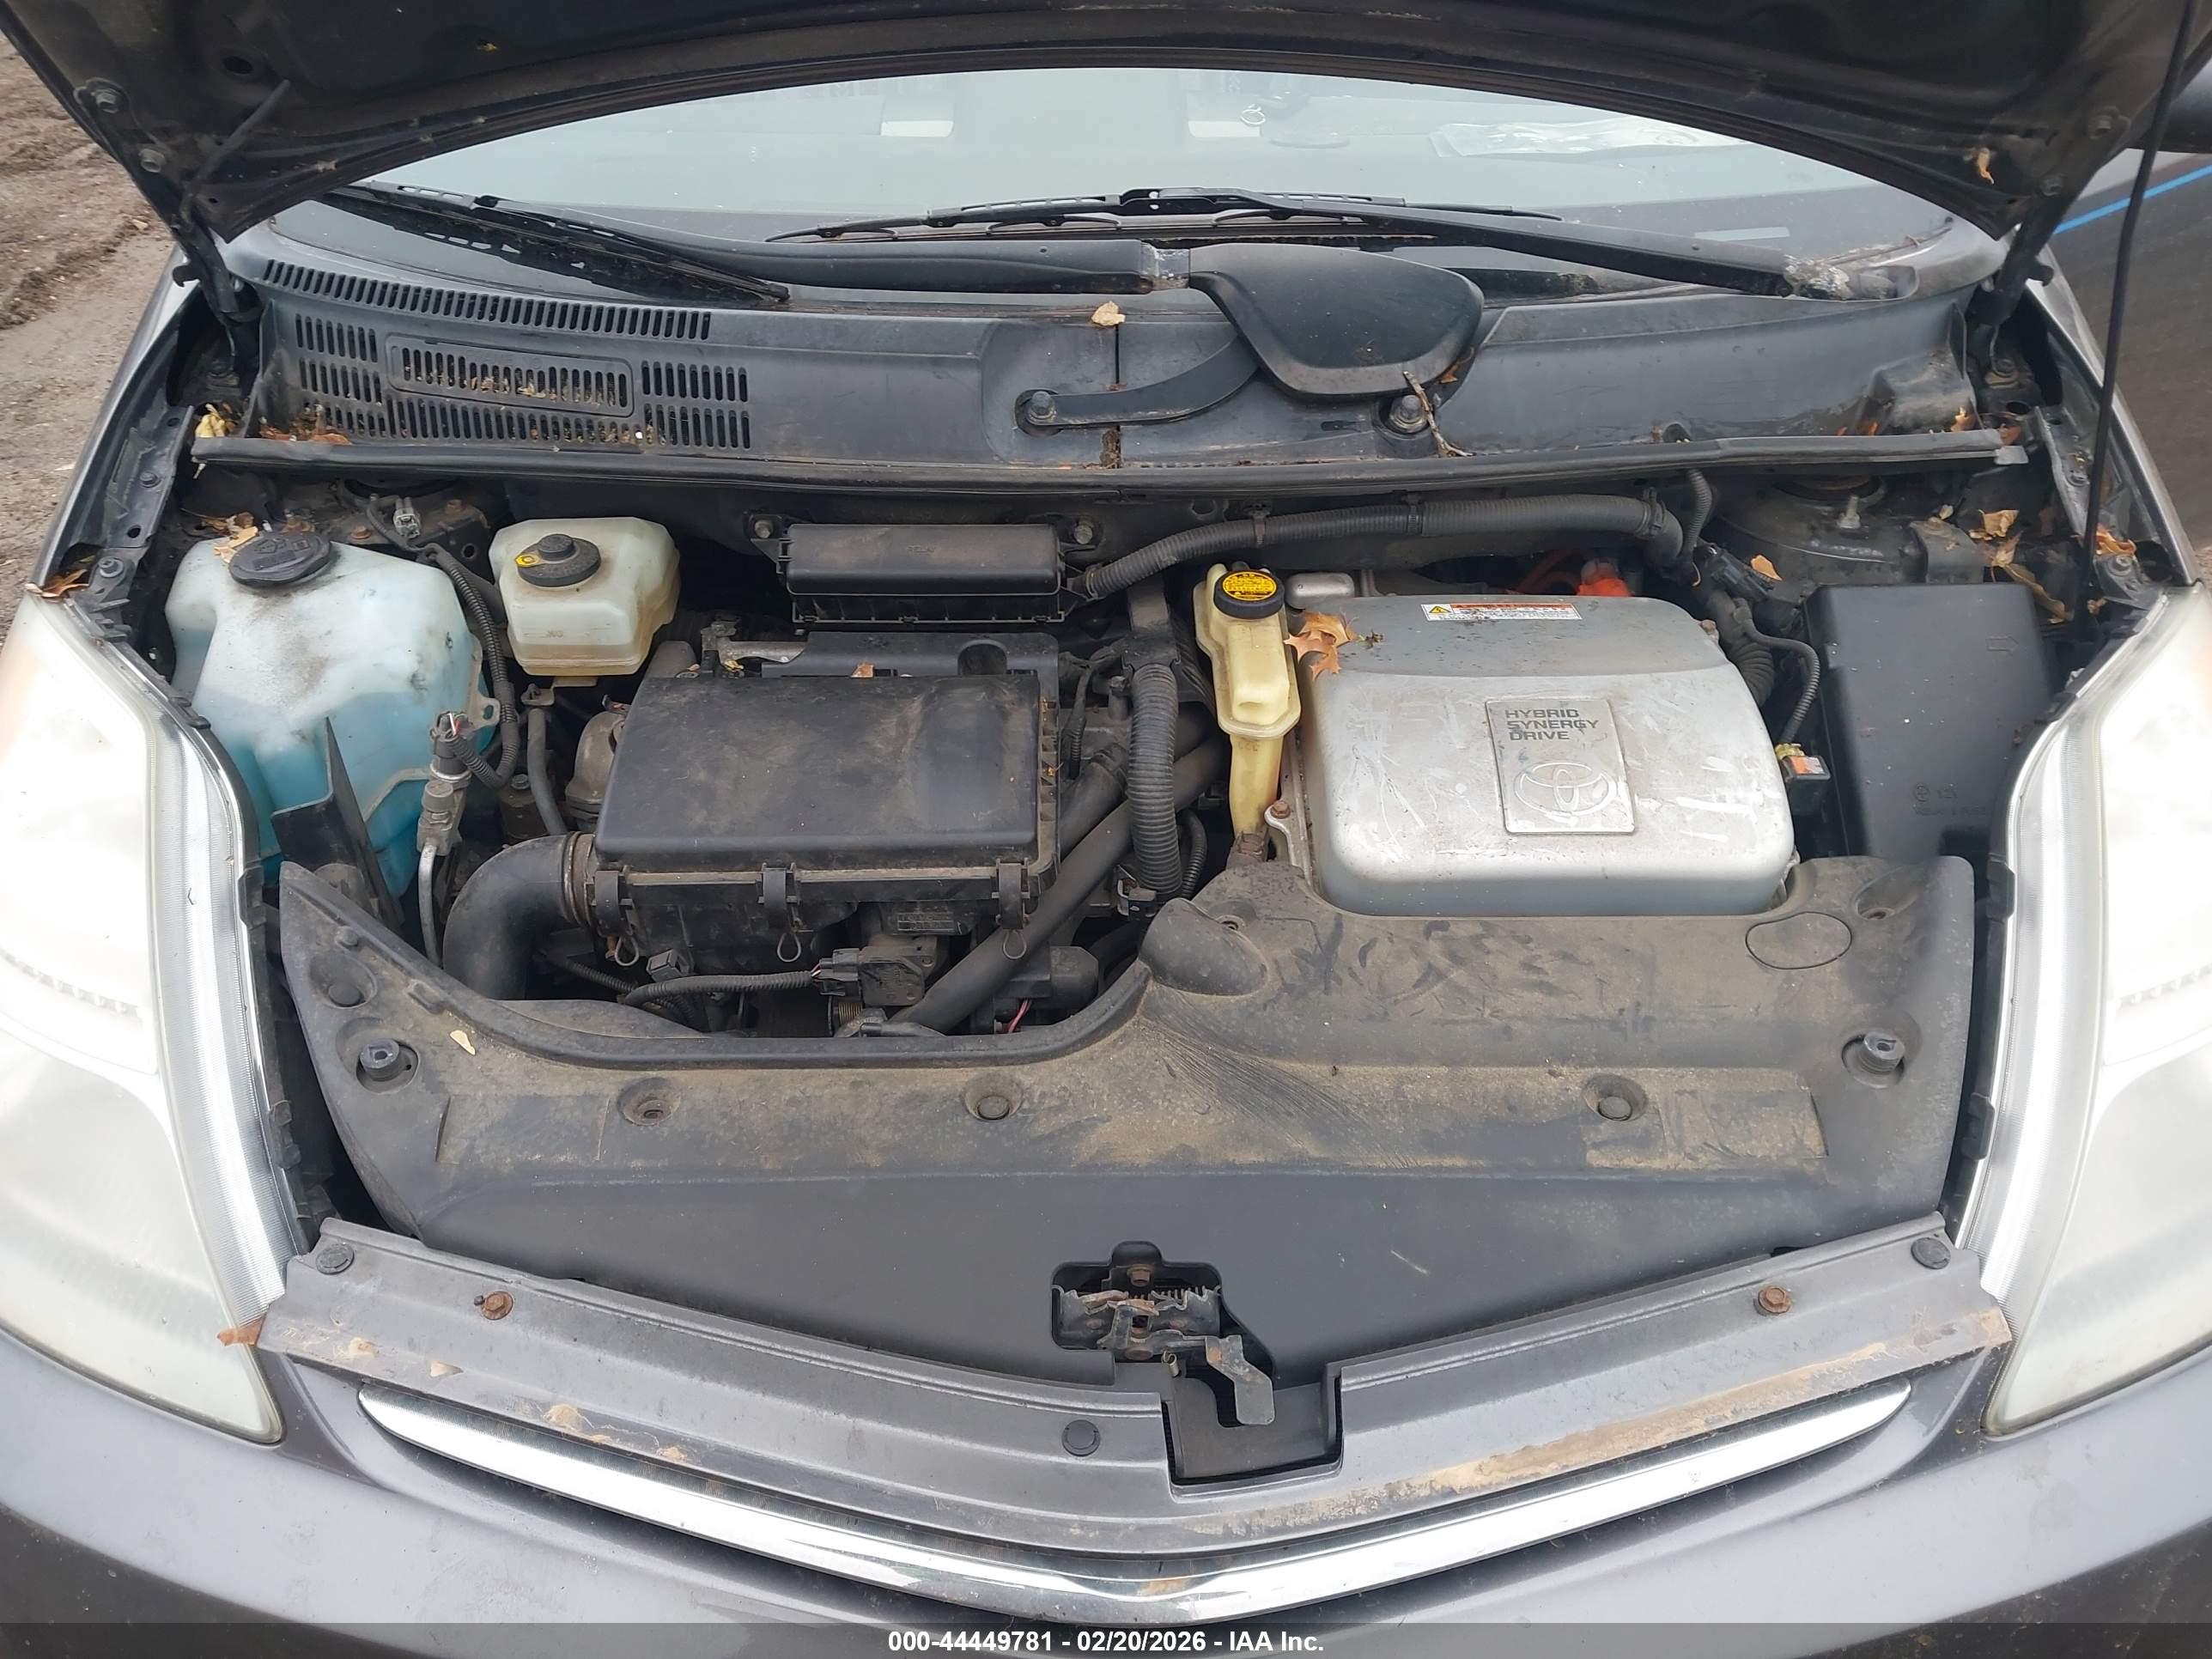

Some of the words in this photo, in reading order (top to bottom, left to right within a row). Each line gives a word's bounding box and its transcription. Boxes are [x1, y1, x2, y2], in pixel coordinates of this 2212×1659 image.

[1505, 708, 1579, 719] HYBRID
[1507, 720, 1599, 730] SYNERGY
[1510, 731, 1570, 740] DRIVE
